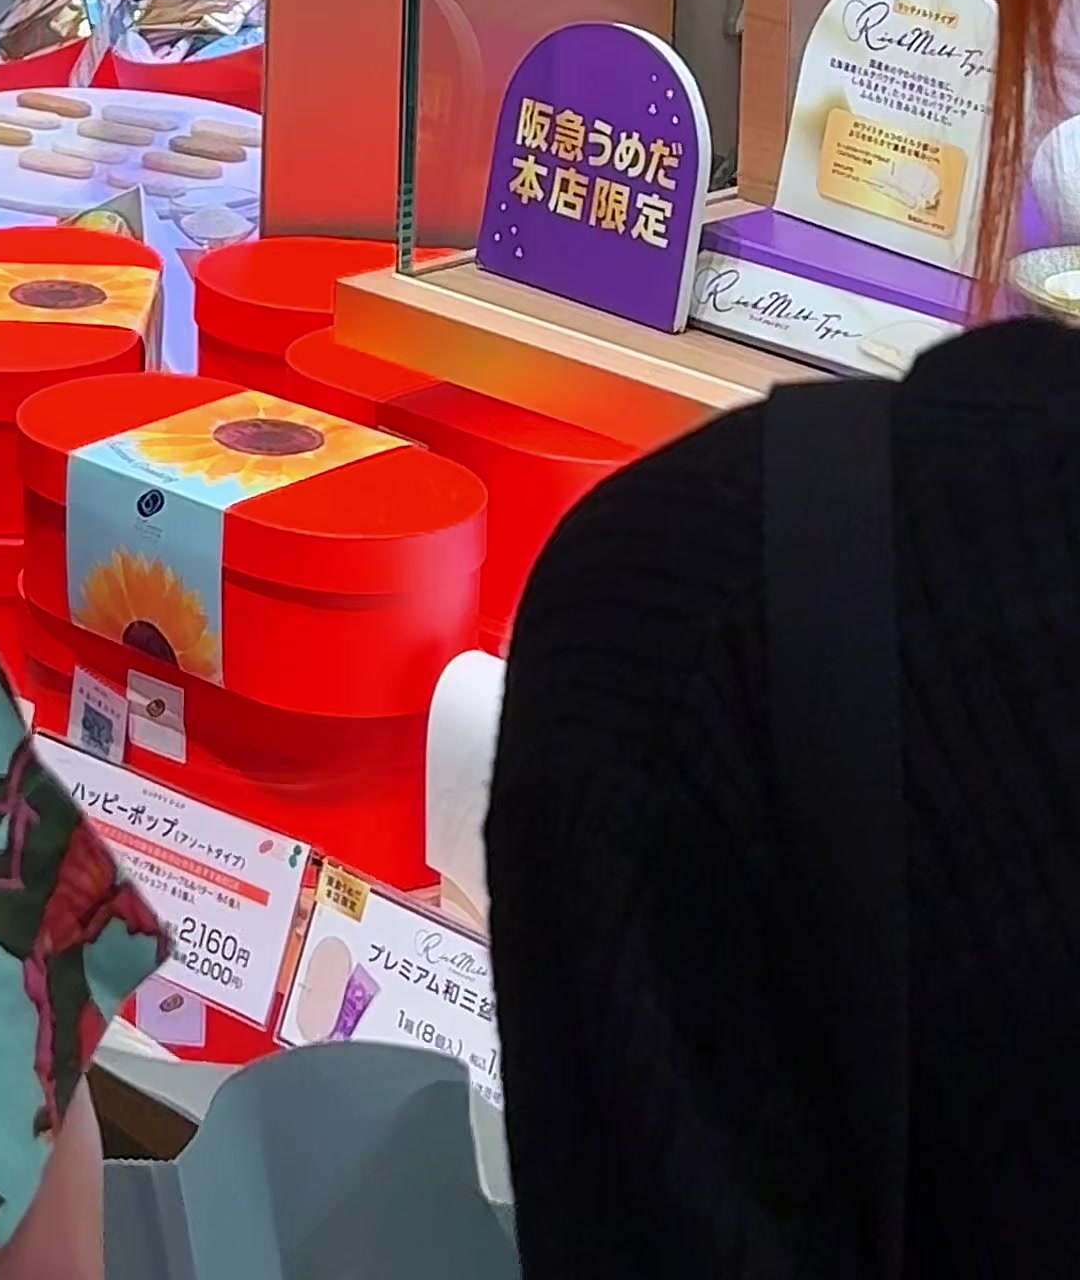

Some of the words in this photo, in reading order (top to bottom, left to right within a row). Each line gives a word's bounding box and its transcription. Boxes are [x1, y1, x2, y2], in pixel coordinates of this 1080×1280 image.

[515, 97, 684, 190] 阪急うめだ
[508, 155, 673, 249] 本店限定
[179, 916, 251, 969] 2,160円
